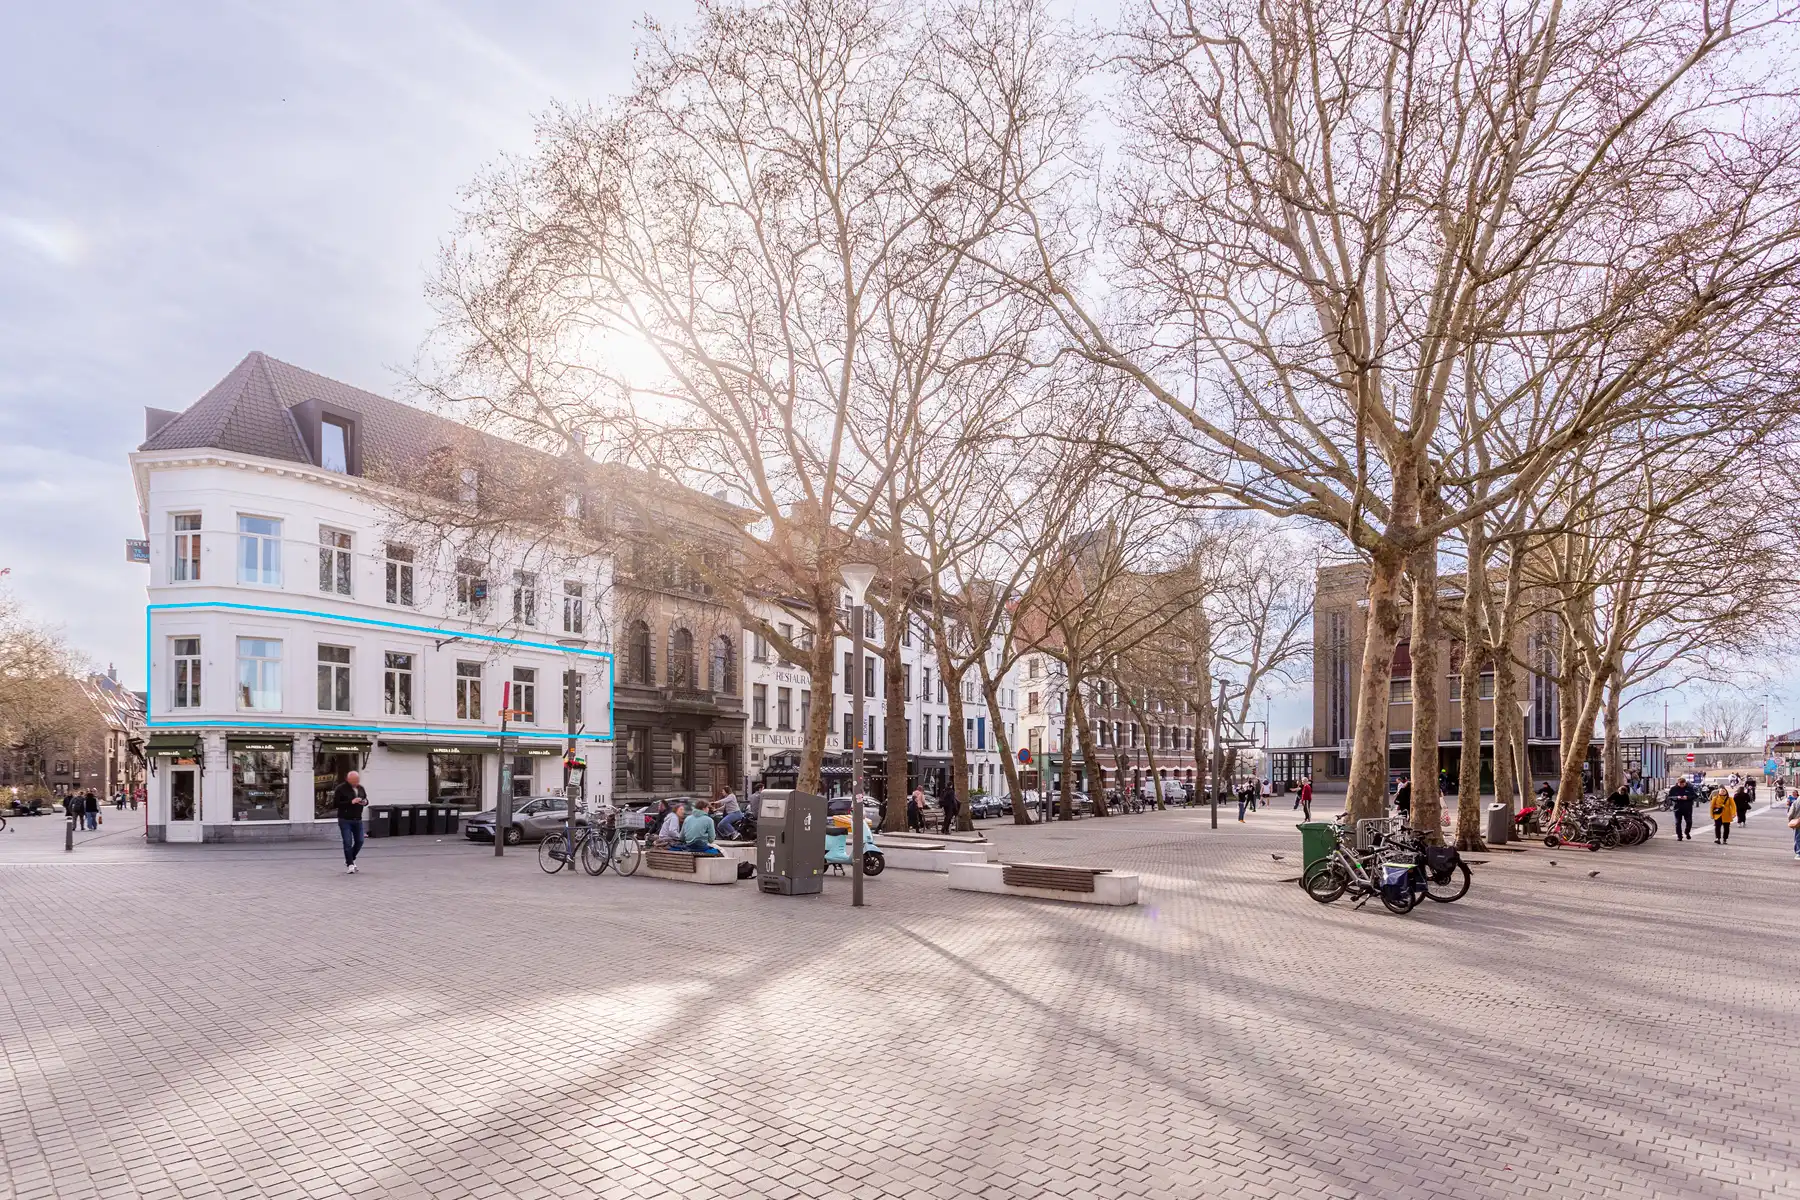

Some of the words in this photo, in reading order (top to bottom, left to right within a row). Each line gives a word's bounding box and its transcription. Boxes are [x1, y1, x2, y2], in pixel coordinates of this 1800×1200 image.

[776, 671, 811, 685] RESTAURA
[751, 733, 766, 744] HET
[769, 734, 796, 746] NIEUWE
